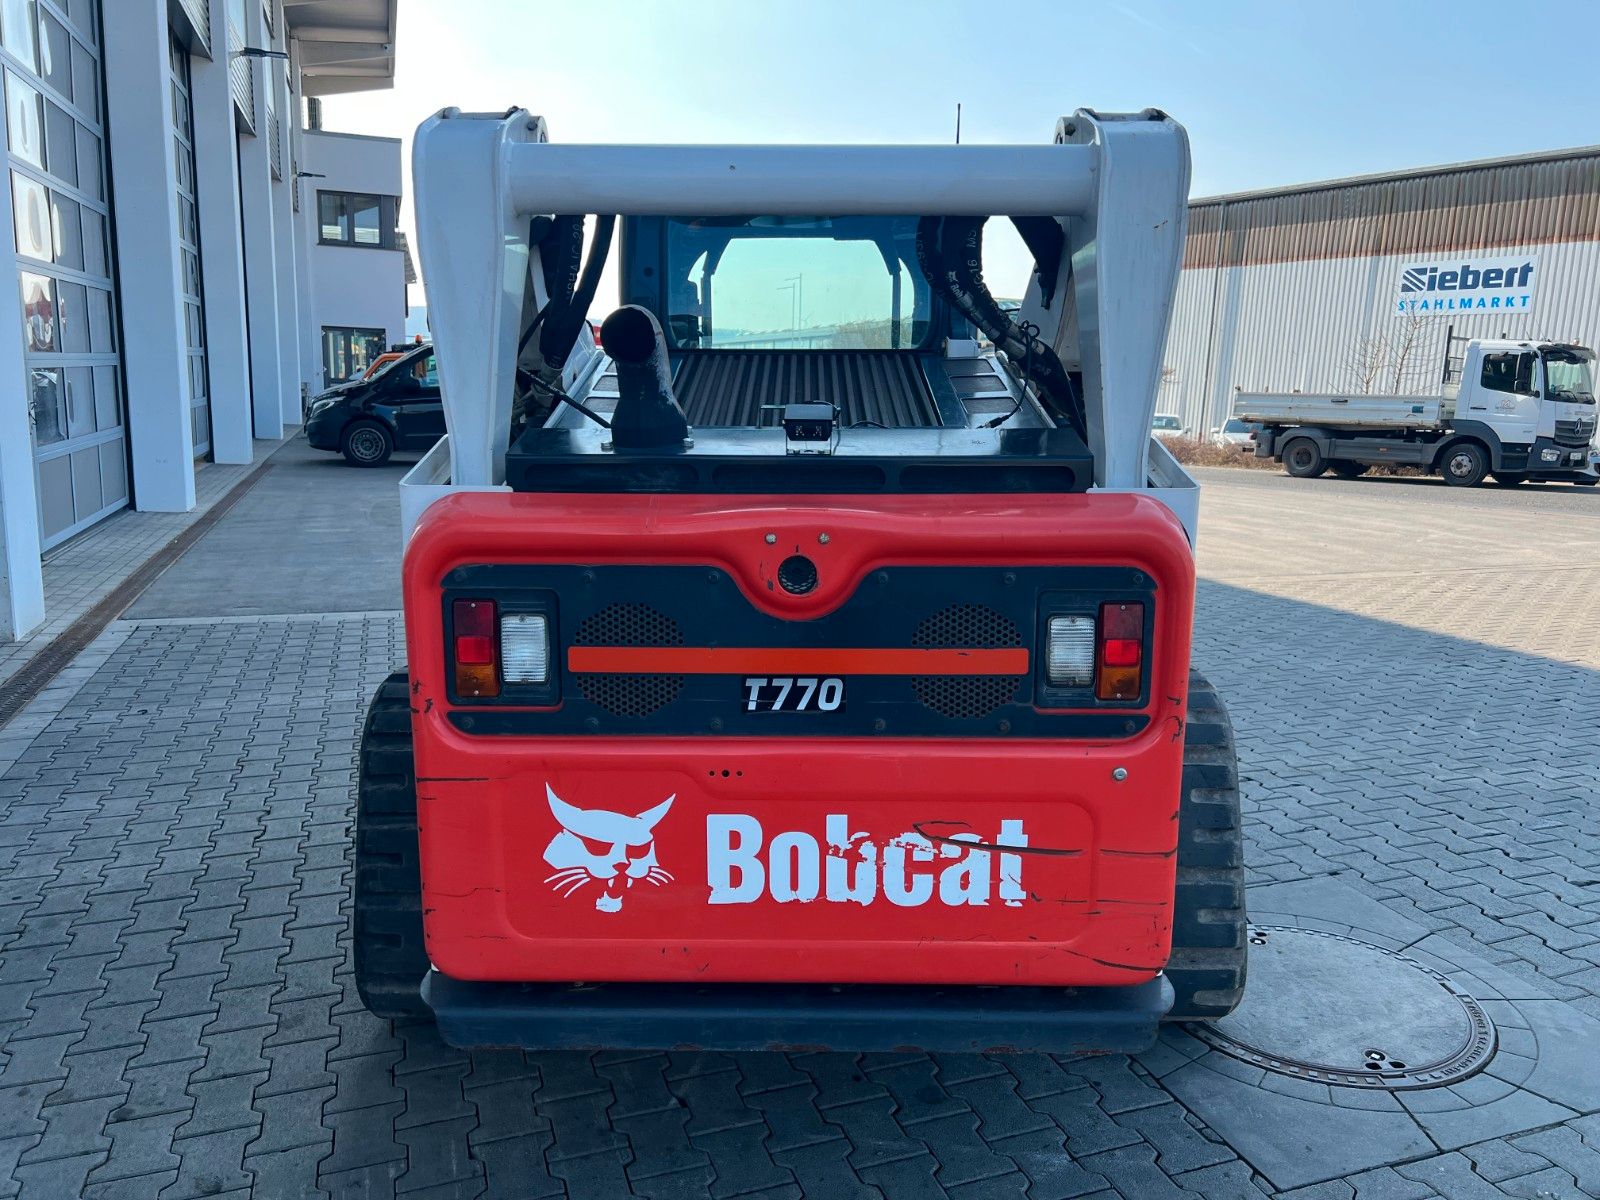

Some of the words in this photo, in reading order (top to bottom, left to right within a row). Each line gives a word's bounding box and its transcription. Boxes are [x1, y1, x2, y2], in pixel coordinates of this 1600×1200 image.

[1401, 262, 1534, 292] Siebert
[1398, 296, 1530, 311] STAHLMARKT
[745, 678, 844, 711] T770
[706, 813, 1029, 907] Bobcat
